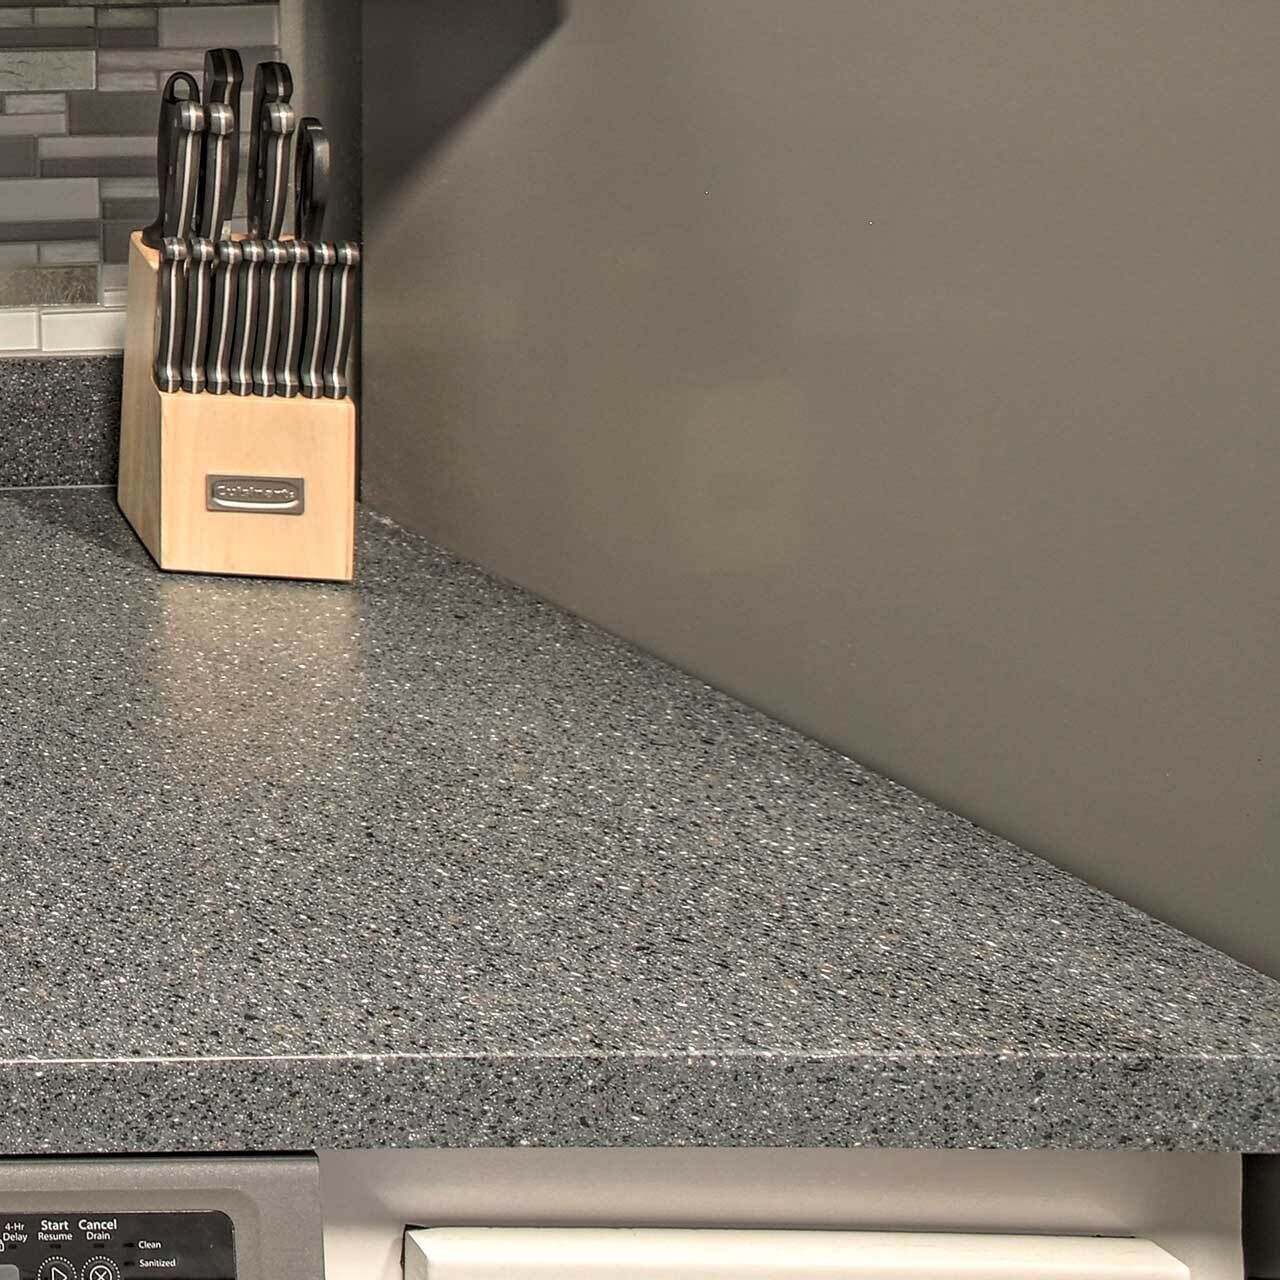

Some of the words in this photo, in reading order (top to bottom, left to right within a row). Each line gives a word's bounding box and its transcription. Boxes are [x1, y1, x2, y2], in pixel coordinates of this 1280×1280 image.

[4, 1222, 25, 1231] 4-Hr
[41, 1219, 69, 1231] Start
[78, 1219, 118, 1231] Cancel
[2, 1232, 28, 1243] Delay
[37, 1231, 73, 1241] Resume
[86, 1231, 111, 1240] Drain
[138, 1240, 162, 1249] Clean
[139, 1258, 177, 1268] Sanitized
